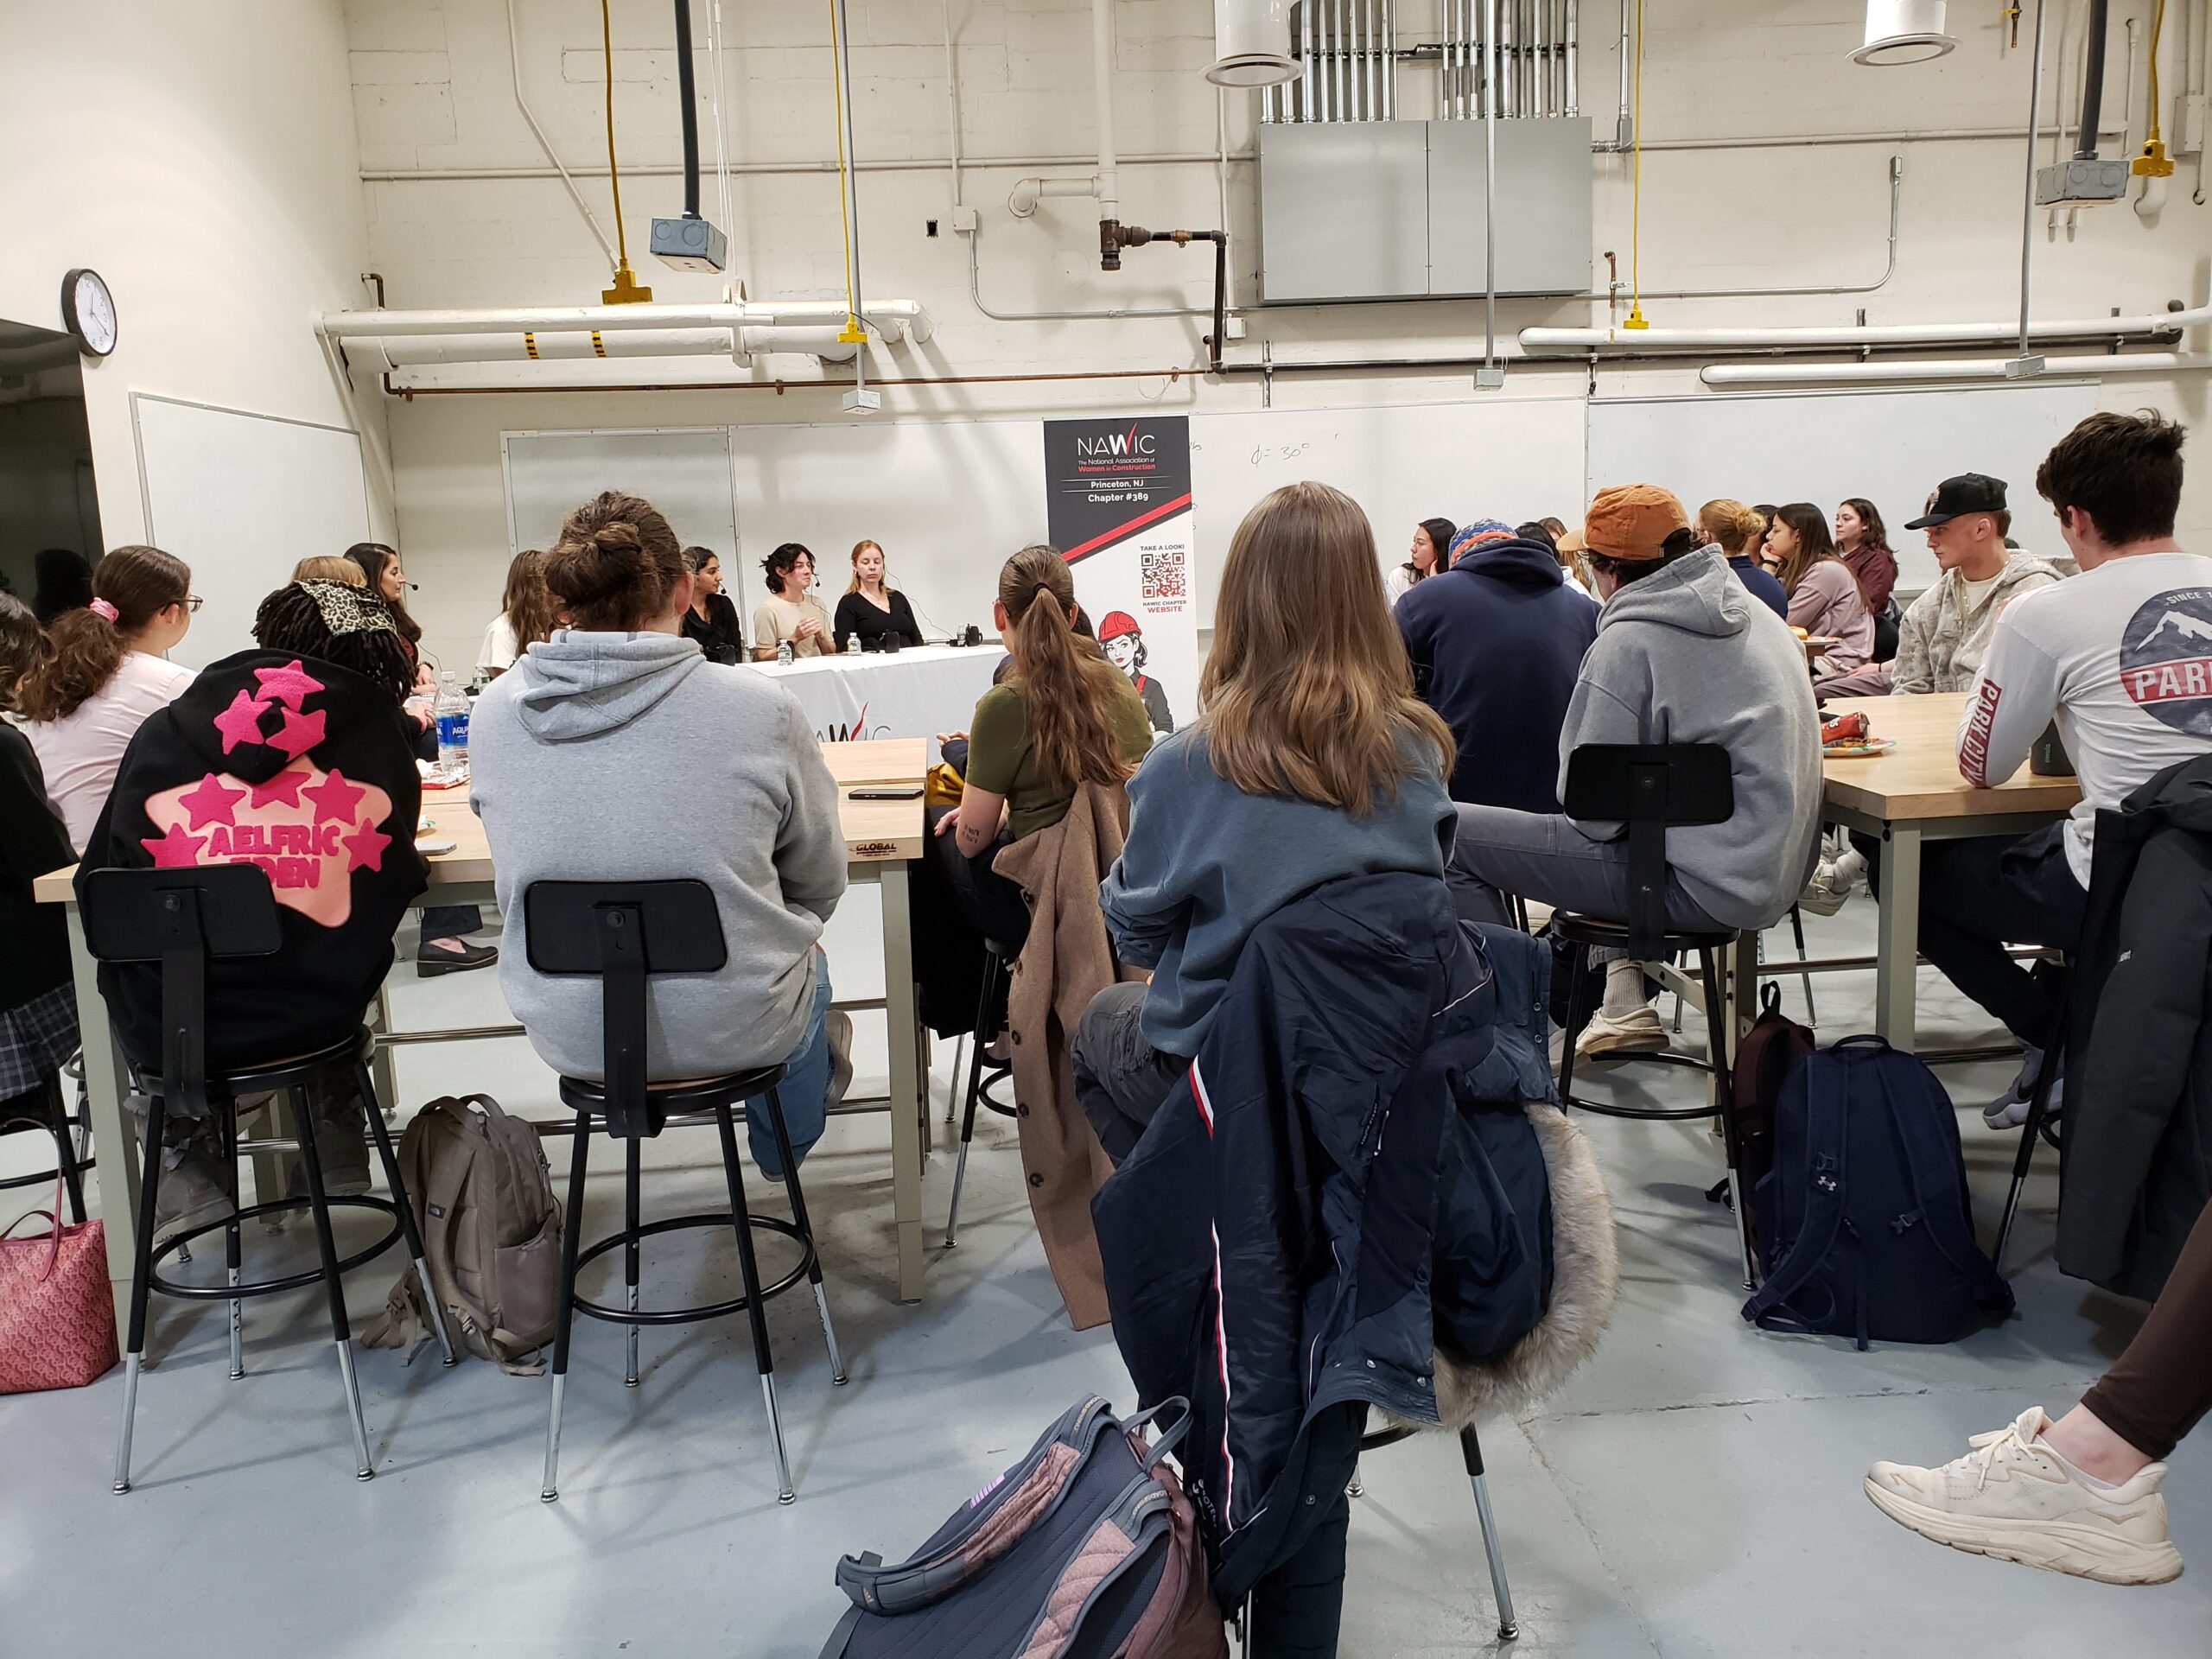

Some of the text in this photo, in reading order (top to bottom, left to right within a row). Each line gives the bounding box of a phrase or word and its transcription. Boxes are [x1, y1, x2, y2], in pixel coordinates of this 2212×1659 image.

[1077, 422, 1155, 456] NAWIC
[1088, 493, 1149, 503] Chapter #389
[1090, 480, 1132, 489] Princeton,
[2166, 591, 2203, 604] SINCE
[2133, 662, 2212, 700] PAR
[1961, 682, 1999, 782] PARK CITY
[207, 824, 341, 857] AELFRIC
[855, 842, 897, 851] GLOBAL
[230, 856, 321, 889] DEN
